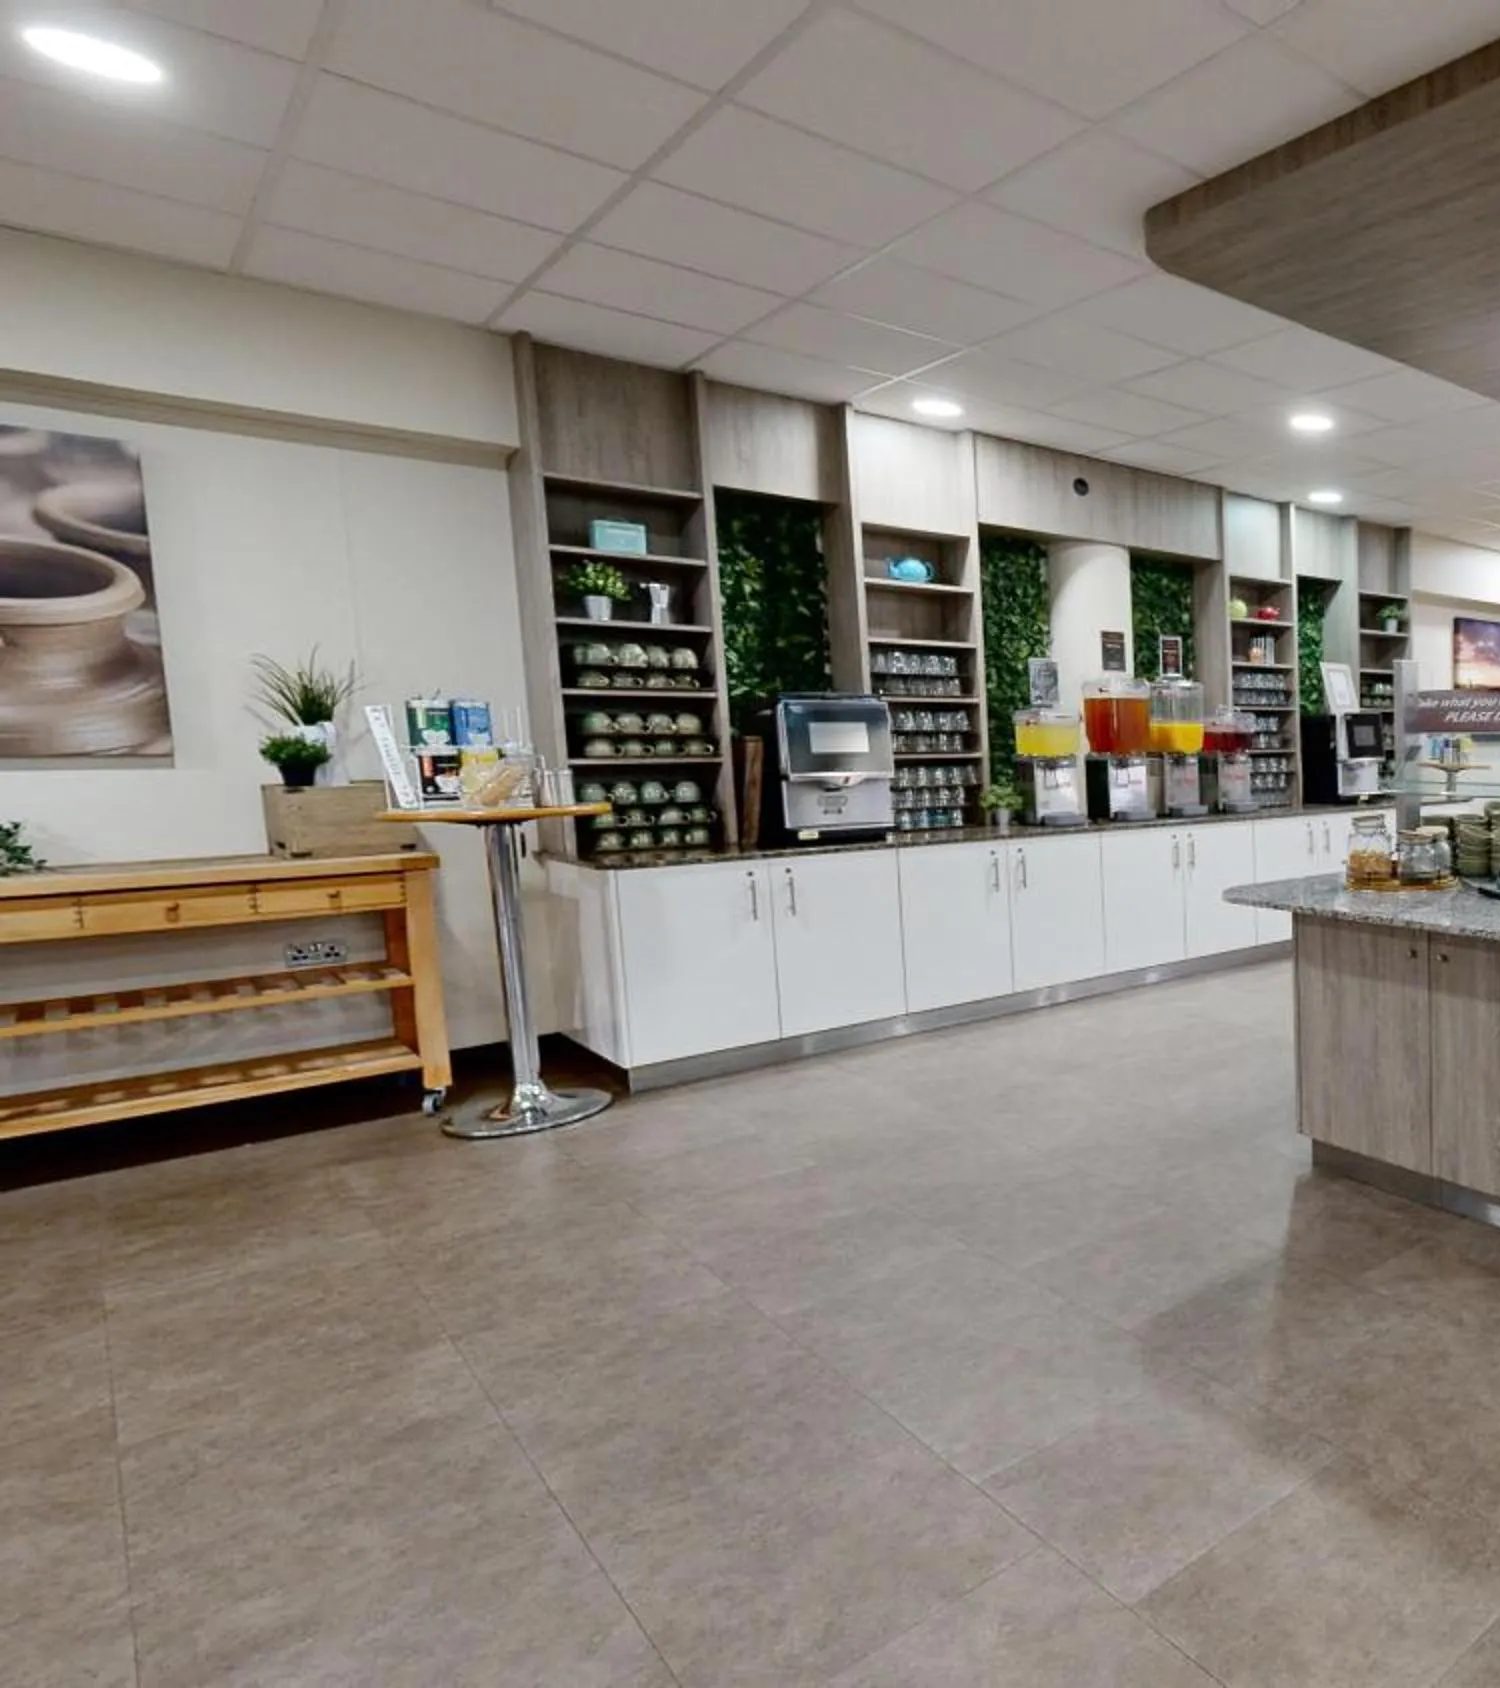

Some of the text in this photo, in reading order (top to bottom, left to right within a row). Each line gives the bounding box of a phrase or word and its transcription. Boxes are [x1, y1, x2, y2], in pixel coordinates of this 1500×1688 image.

[1440, 696, 1469, 707] what
[1468, 697, 1496, 709] you
[1445, 710, 1494, 722] PLEASE
